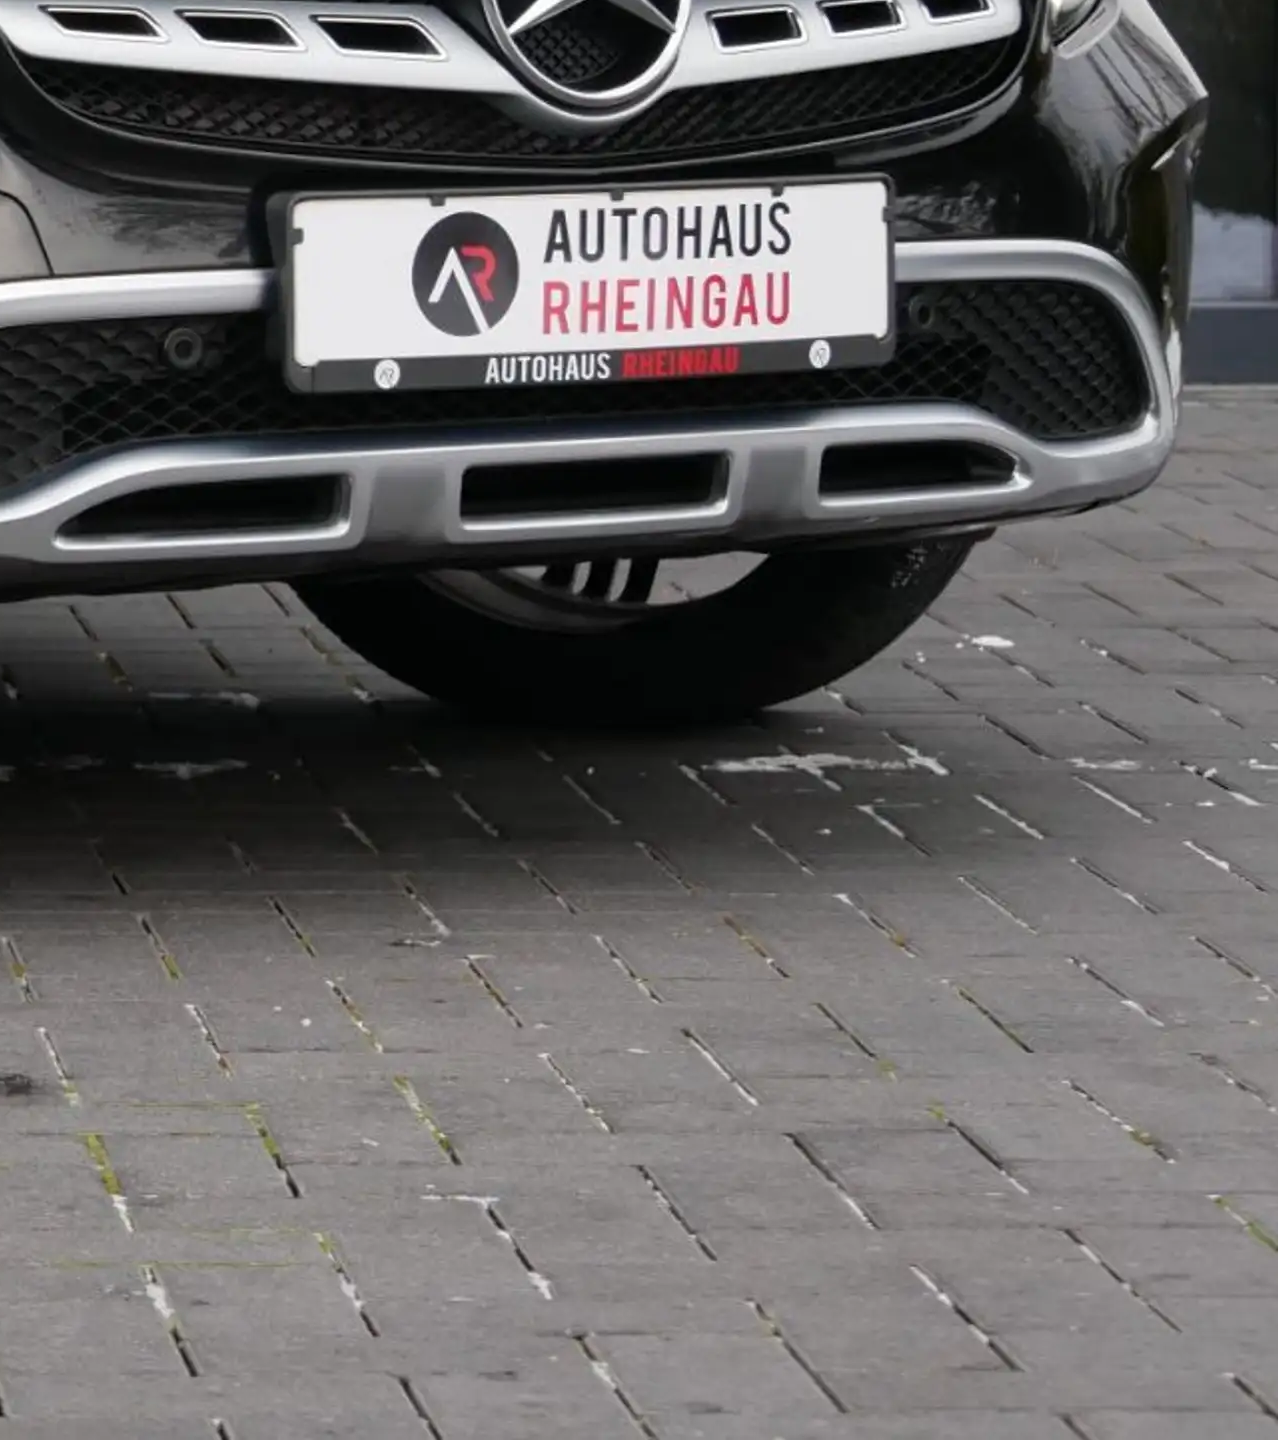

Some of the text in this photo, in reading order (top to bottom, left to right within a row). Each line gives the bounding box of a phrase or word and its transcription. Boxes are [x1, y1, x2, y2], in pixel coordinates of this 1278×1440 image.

[543, 201, 792, 264] AUTOHAUS
[542, 271, 791, 335] RHEINGAU
[484, 346, 740, 385] AUTOHAUS RHEINGAU
